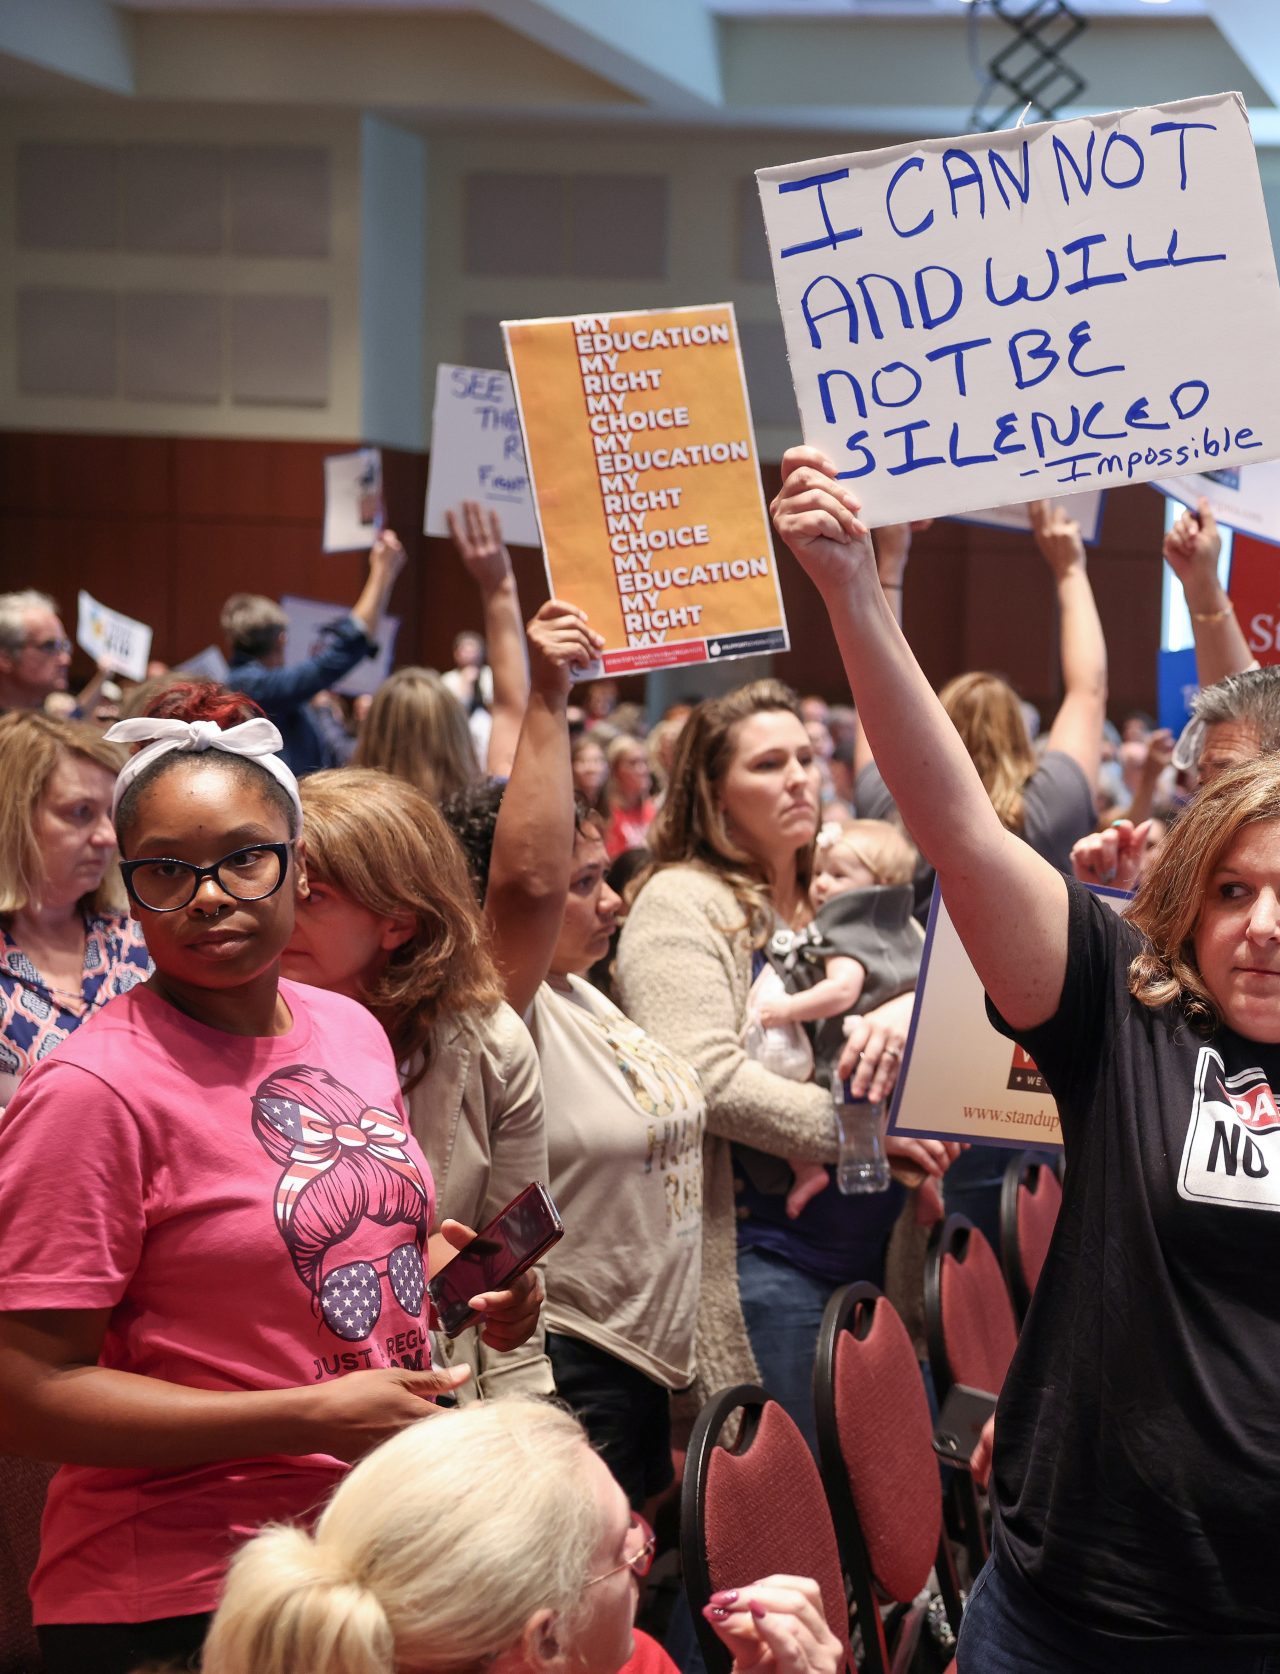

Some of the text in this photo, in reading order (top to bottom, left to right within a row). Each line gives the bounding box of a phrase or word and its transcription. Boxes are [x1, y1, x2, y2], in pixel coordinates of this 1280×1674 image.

[778, 168, 863, 259] I
[801, 229, 1227, 349] AND WILL
[573, 317, 612, 335] MY
[576, 323, 730, 355] EDUCATION
[580, 352, 620, 375] MY
[818, 320, 1126, 424] NOT BE
[451, 368, 505, 403] SEE
[583, 369, 663, 394] RIGHT
[586, 393, 627, 415] MY
[590, 407, 690, 435] CHOICE
[835, 379, 1210, 480] SILENCED
[593, 432, 633, 455] MY
[597, 440, 750, 475] EDUCATION
[600, 472, 640, 494] MY
[603, 487, 682, 514] RIGHT
[606, 511, 647, 535] MY
[610, 524, 711, 553] CHOICE
[613, 551, 653, 574] MY
[617, 557, 770, 594] EDUCATION
[621, 590, 661, 614] MY
[624, 605, 704, 633] RIGHT
[627, 629, 667, 649] MY
[1027, 1075, 1043, 1087] WE
[313, 1348, 373, 1380] JUST
